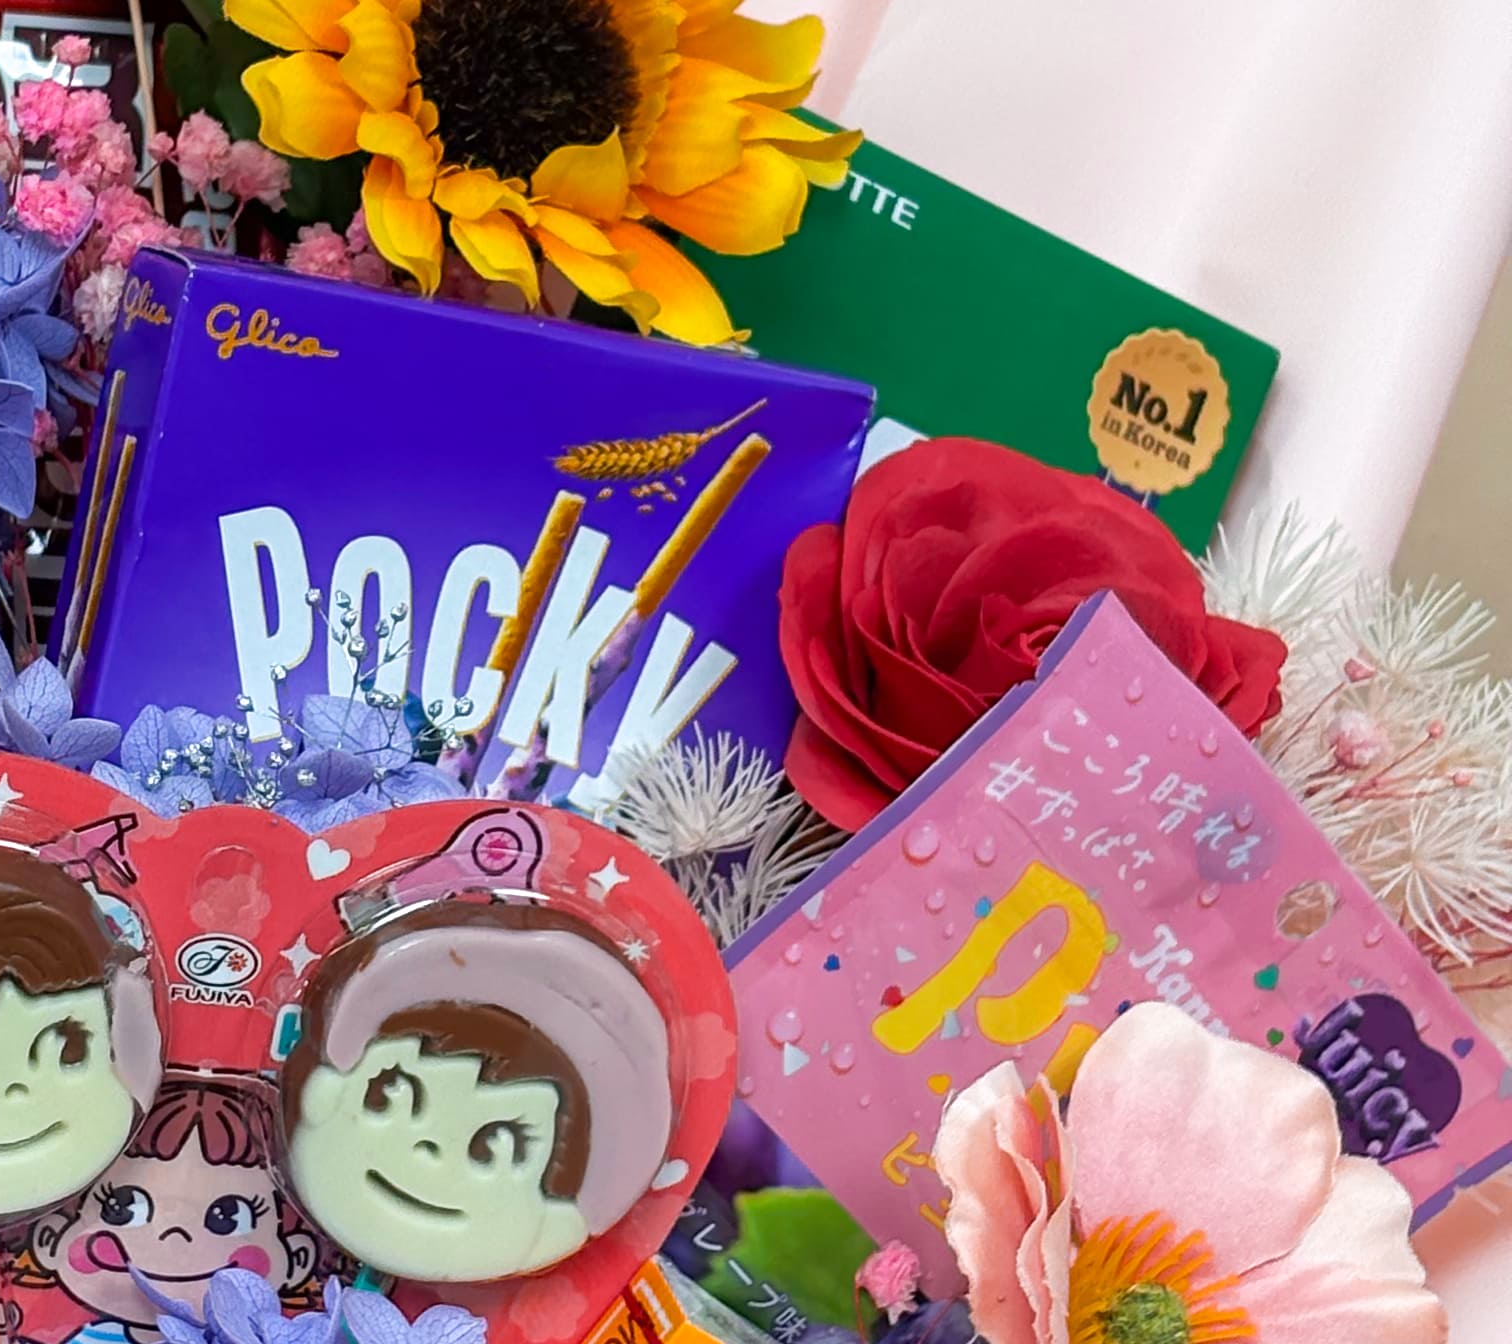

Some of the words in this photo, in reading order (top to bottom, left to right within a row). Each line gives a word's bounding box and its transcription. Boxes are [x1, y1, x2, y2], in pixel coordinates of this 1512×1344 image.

[849, 169, 920, 231] TTE
[205, 302, 340, 360] Glico
[1109, 370, 1208, 446] No.1
[1100, 409, 1123, 438] in
[1122, 420, 1192, 470] Korea
[170, 984, 254, 1008] FUJIYA
